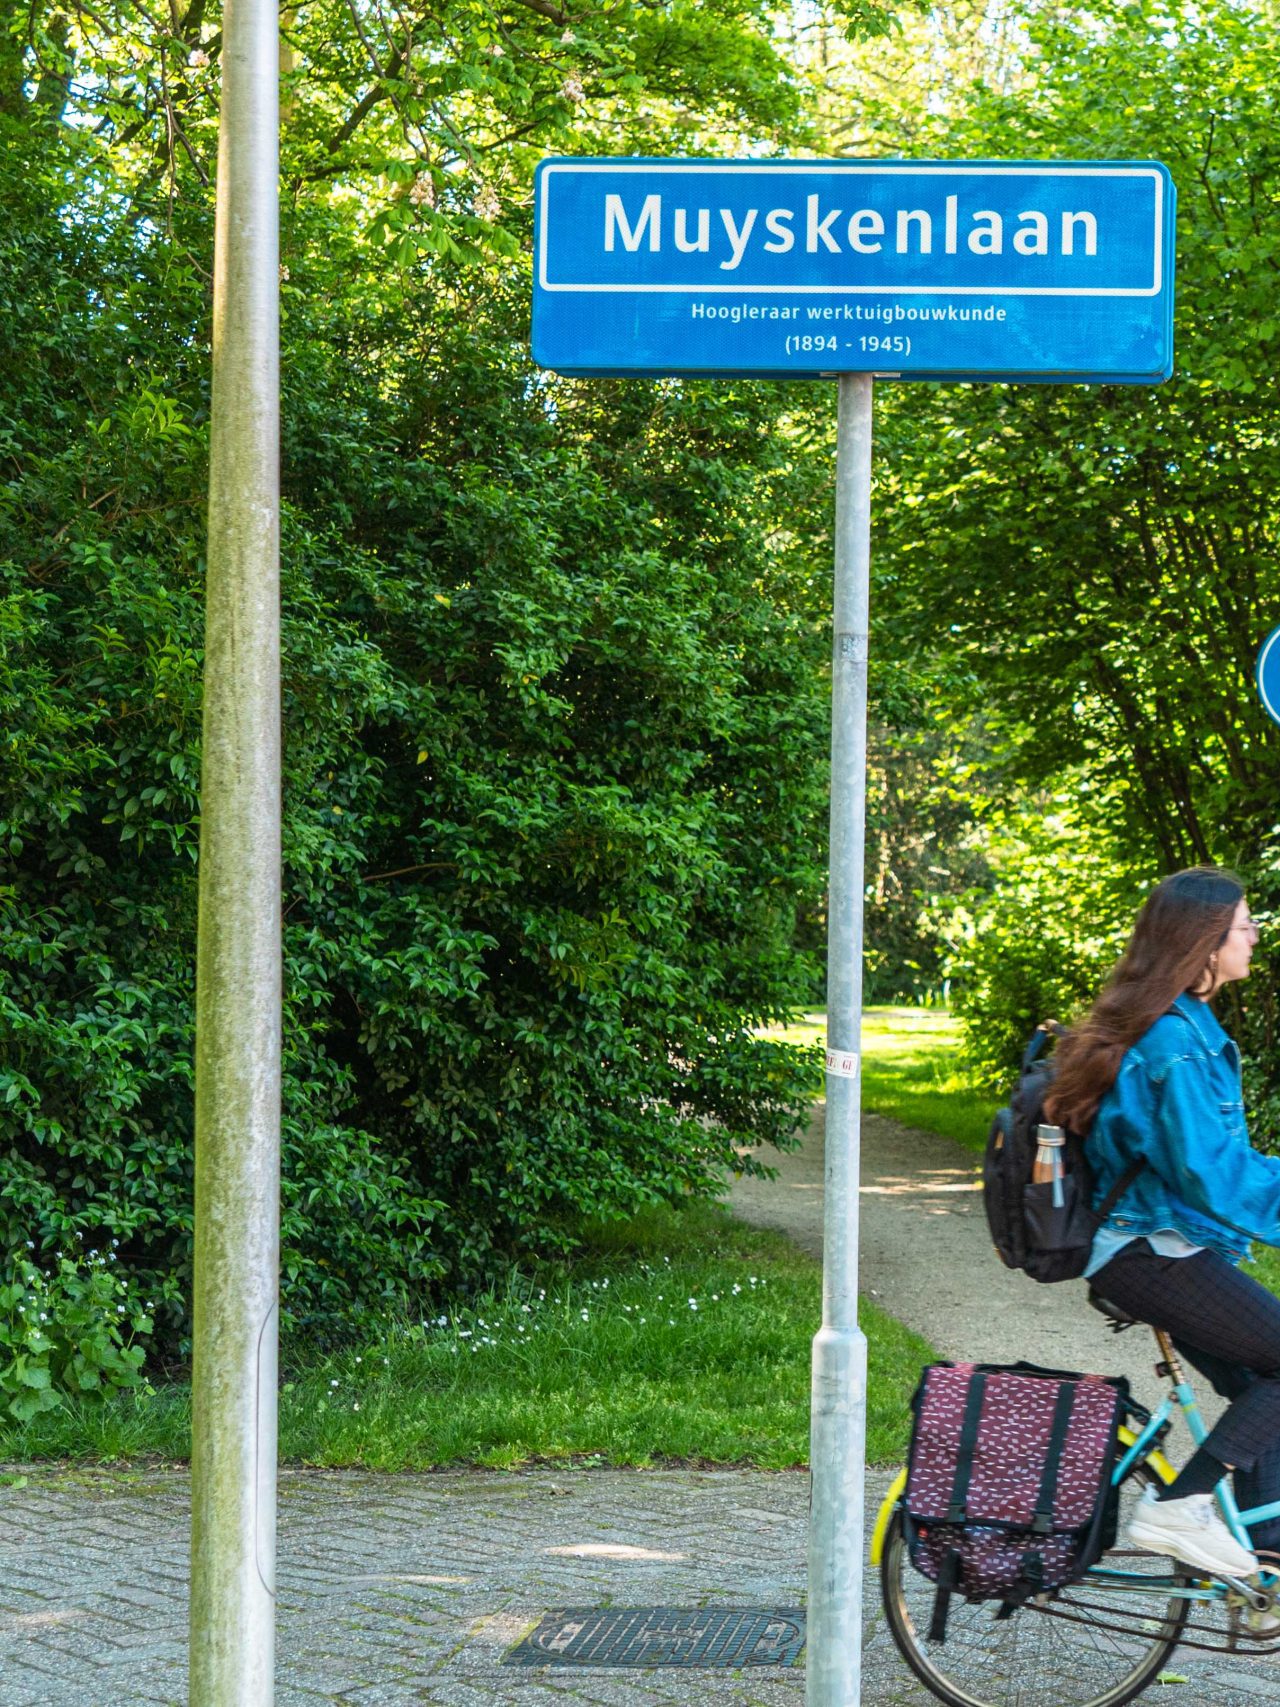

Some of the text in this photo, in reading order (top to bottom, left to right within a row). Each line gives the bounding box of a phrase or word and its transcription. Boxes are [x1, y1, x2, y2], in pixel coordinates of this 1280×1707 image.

[604, 193, 1098, 270] Muyskenlaan
[691, 302, 1007, 325] Hoogleraar werktuigbouwkunde
[785, 335, 838, 355] (1894
[859, 336, 912, 356] 1945)
